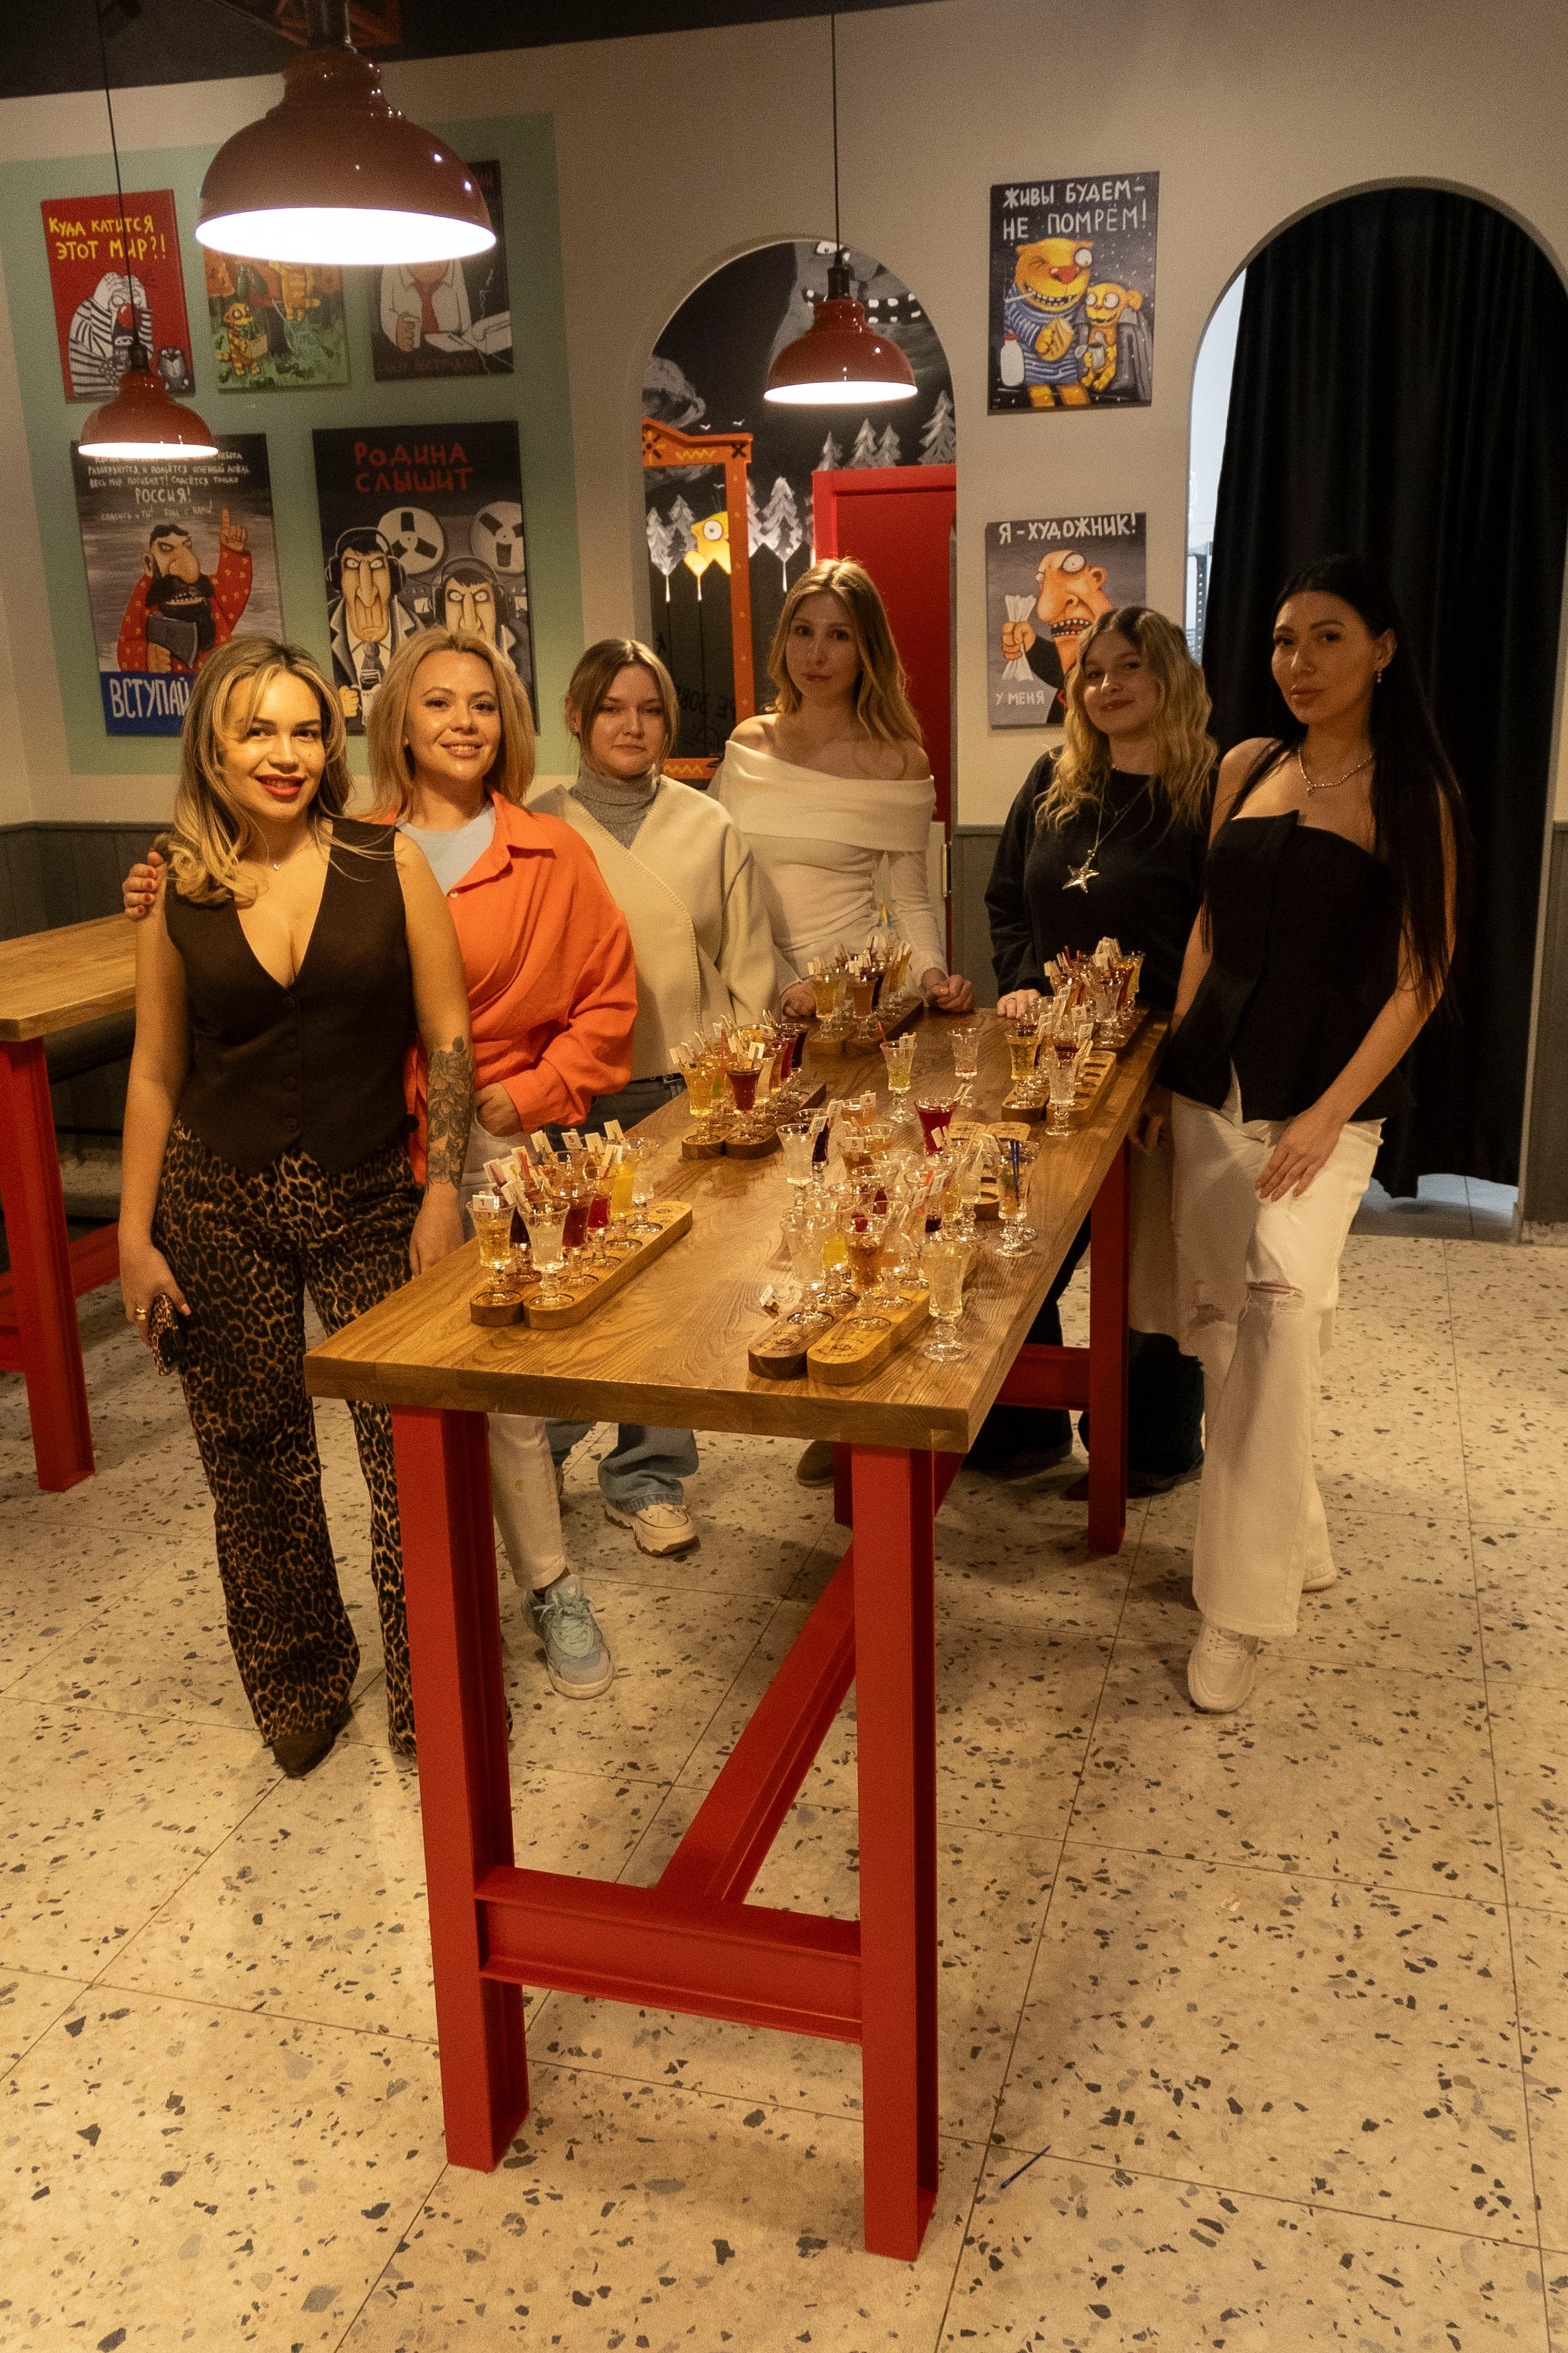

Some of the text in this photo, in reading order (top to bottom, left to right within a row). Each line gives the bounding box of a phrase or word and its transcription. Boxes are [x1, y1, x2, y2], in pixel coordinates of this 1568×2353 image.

[1003, 187, 1054, 209] ЖИВЫ
[91, 214, 154, 233] КАТИТСЯ
[1003, 198, 1147, 240] НЕ ПОМРЁМ!
[56, 233, 166, 261] ЭТОТ МИР?!
[90, 478, 106, 488] ВЕСЬ
[109, 478, 123, 487] МИР
[213, 476, 239, 484] ТОЛЬКО
[355, 467, 473, 493] СЛЫШИТ
[135, 485, 191, 504] РОССИЯ!
[998, 523, 1012, 545] Я
[109, 677, 190, 719] ВСТУПАЙ
[996, 690, 1046, 706] У МЕНЯ
